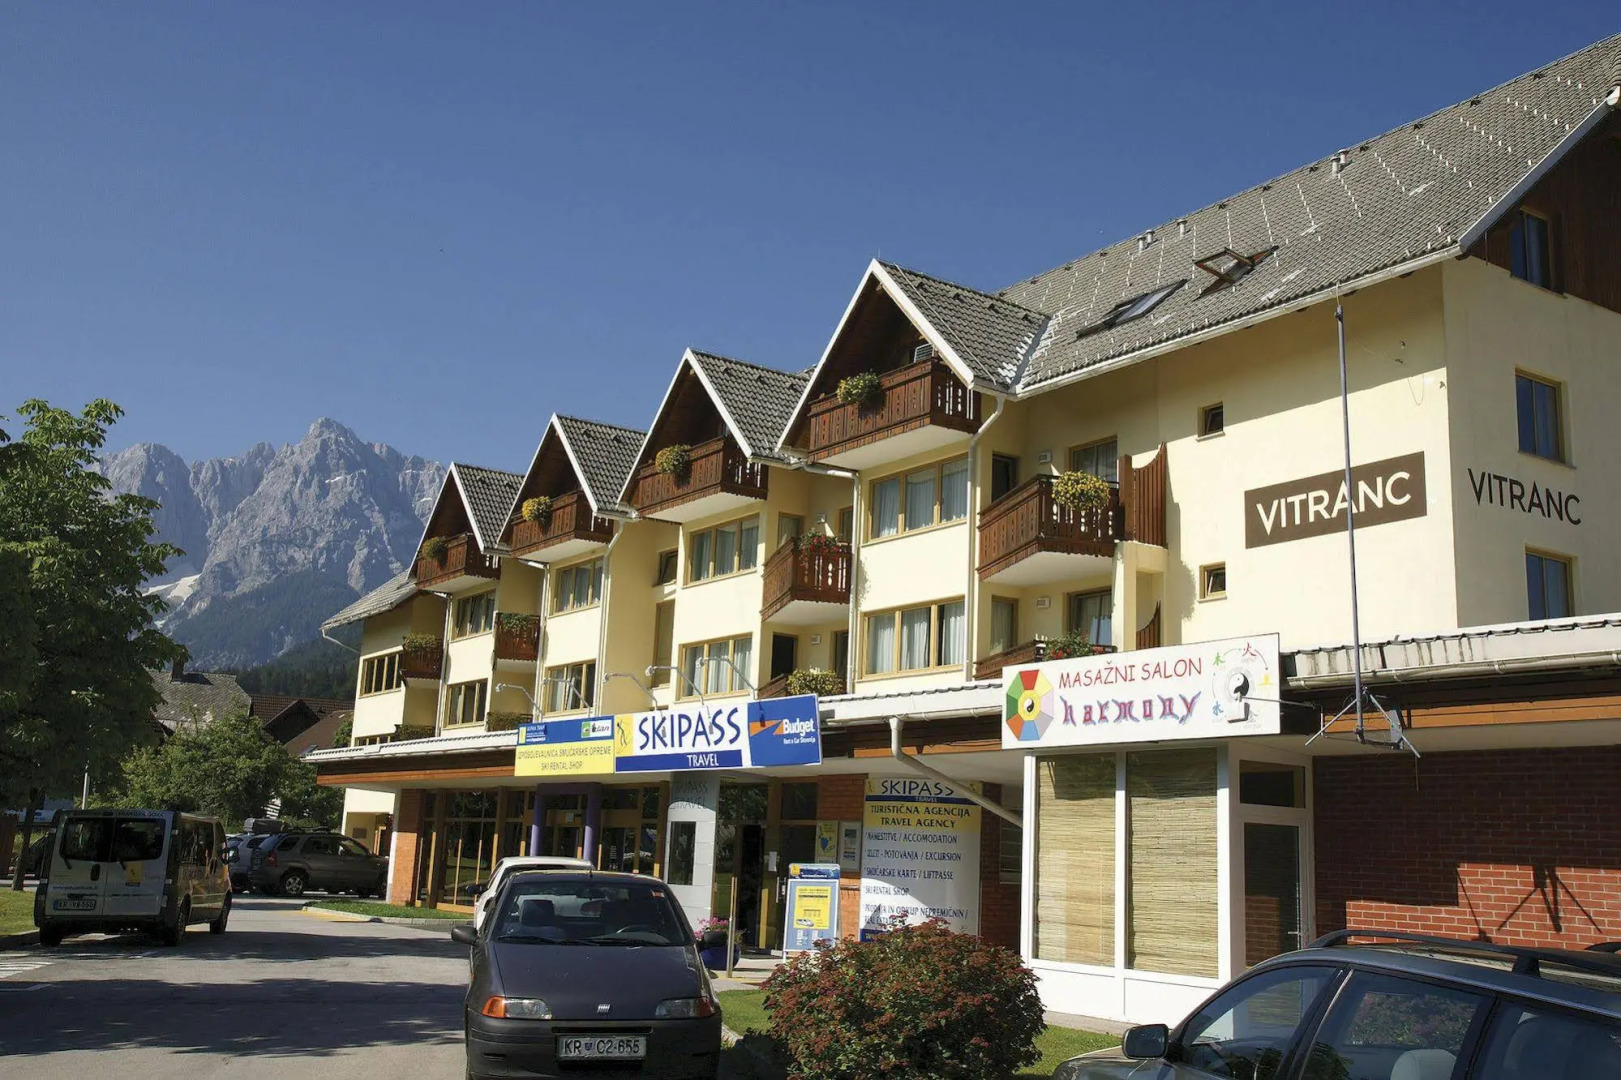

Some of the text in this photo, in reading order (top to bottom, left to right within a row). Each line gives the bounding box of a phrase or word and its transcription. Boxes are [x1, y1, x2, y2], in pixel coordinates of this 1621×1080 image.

[1256, 470, 1412, 536] VITRANC
[1467, 468, 1582, 526] VITRANC
[1059, 657, 1202, 689] MASAŽNI SALON
[639, 707, 741, 750] SKIPASS
[782, 717, 816, 737] Budget
[687, 753, 719, 767] TRAVEL
[871, 803, 970, 818] TURISTIČNA AGENCIJA
[881, 817, 956, 828] TRAVEL AGENCY
[903, 833, 958, 844] ACCOMODATION
[925, 852, 961, 862] EXCURSION
[897, 869, 917, 879] KARTE
[564, 1040, 581, 1055] KR
